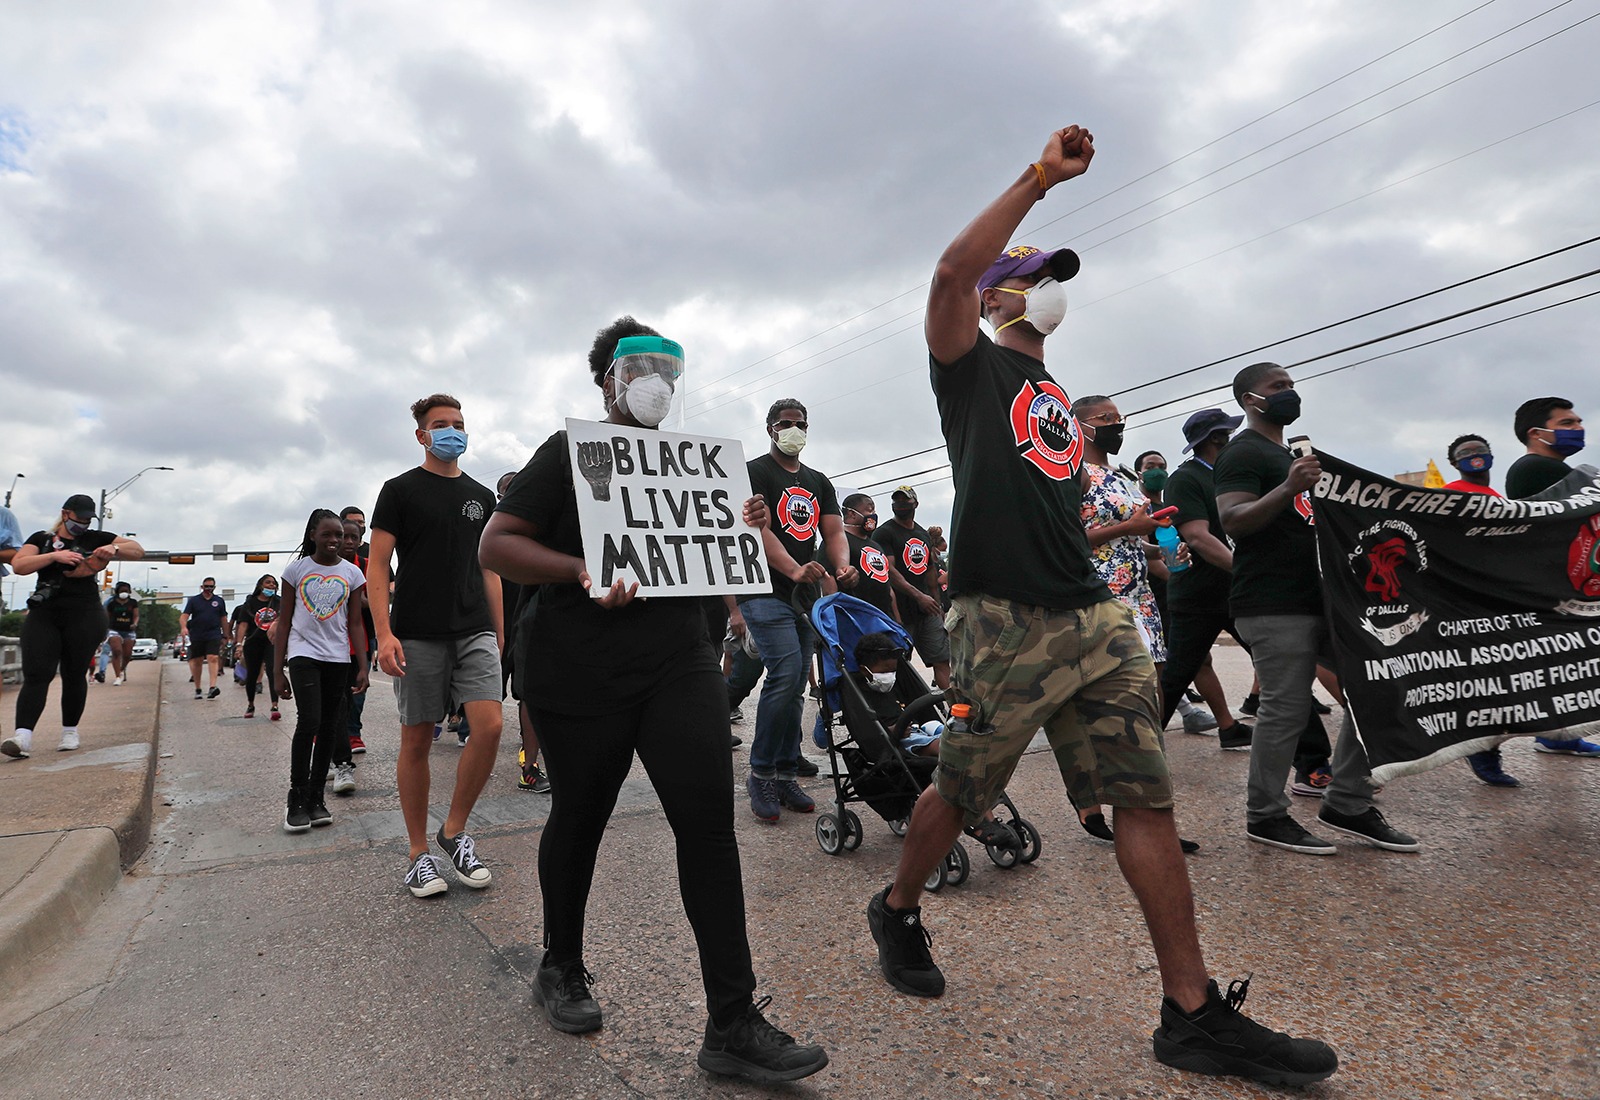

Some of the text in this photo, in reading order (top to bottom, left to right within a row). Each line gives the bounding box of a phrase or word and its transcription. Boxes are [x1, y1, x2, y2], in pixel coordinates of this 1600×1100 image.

[1040, 419, 1071, 442] DALLAS
[611, 436, 728, 478] BLACK
[620, 486, 735, 529] LIVES
[1314, 470, 1402, 509] BLACK
[1396, 490, 1464, 515] FIRE
[1358, 521, 1381, 540] FIRE
[1382, 519, 1418, 540] FIGHTERS
[1465, 523, 1532, 537] OF DALLAS
[601, 532, 765, 587] MATTER
[1366, 603, 1409, 617] OF DALLAS
[1437, 612, 1542, 637] CHAPTER OF THE
[1470, 631, 1586, 666] ASSOCIATION
[1586, 625, 1600, 645] O
[1404, 657, 1600, 707] PROFESSIONAL FIRE FIGHT
[1466, 700, 1549, 727] CENTRAL
